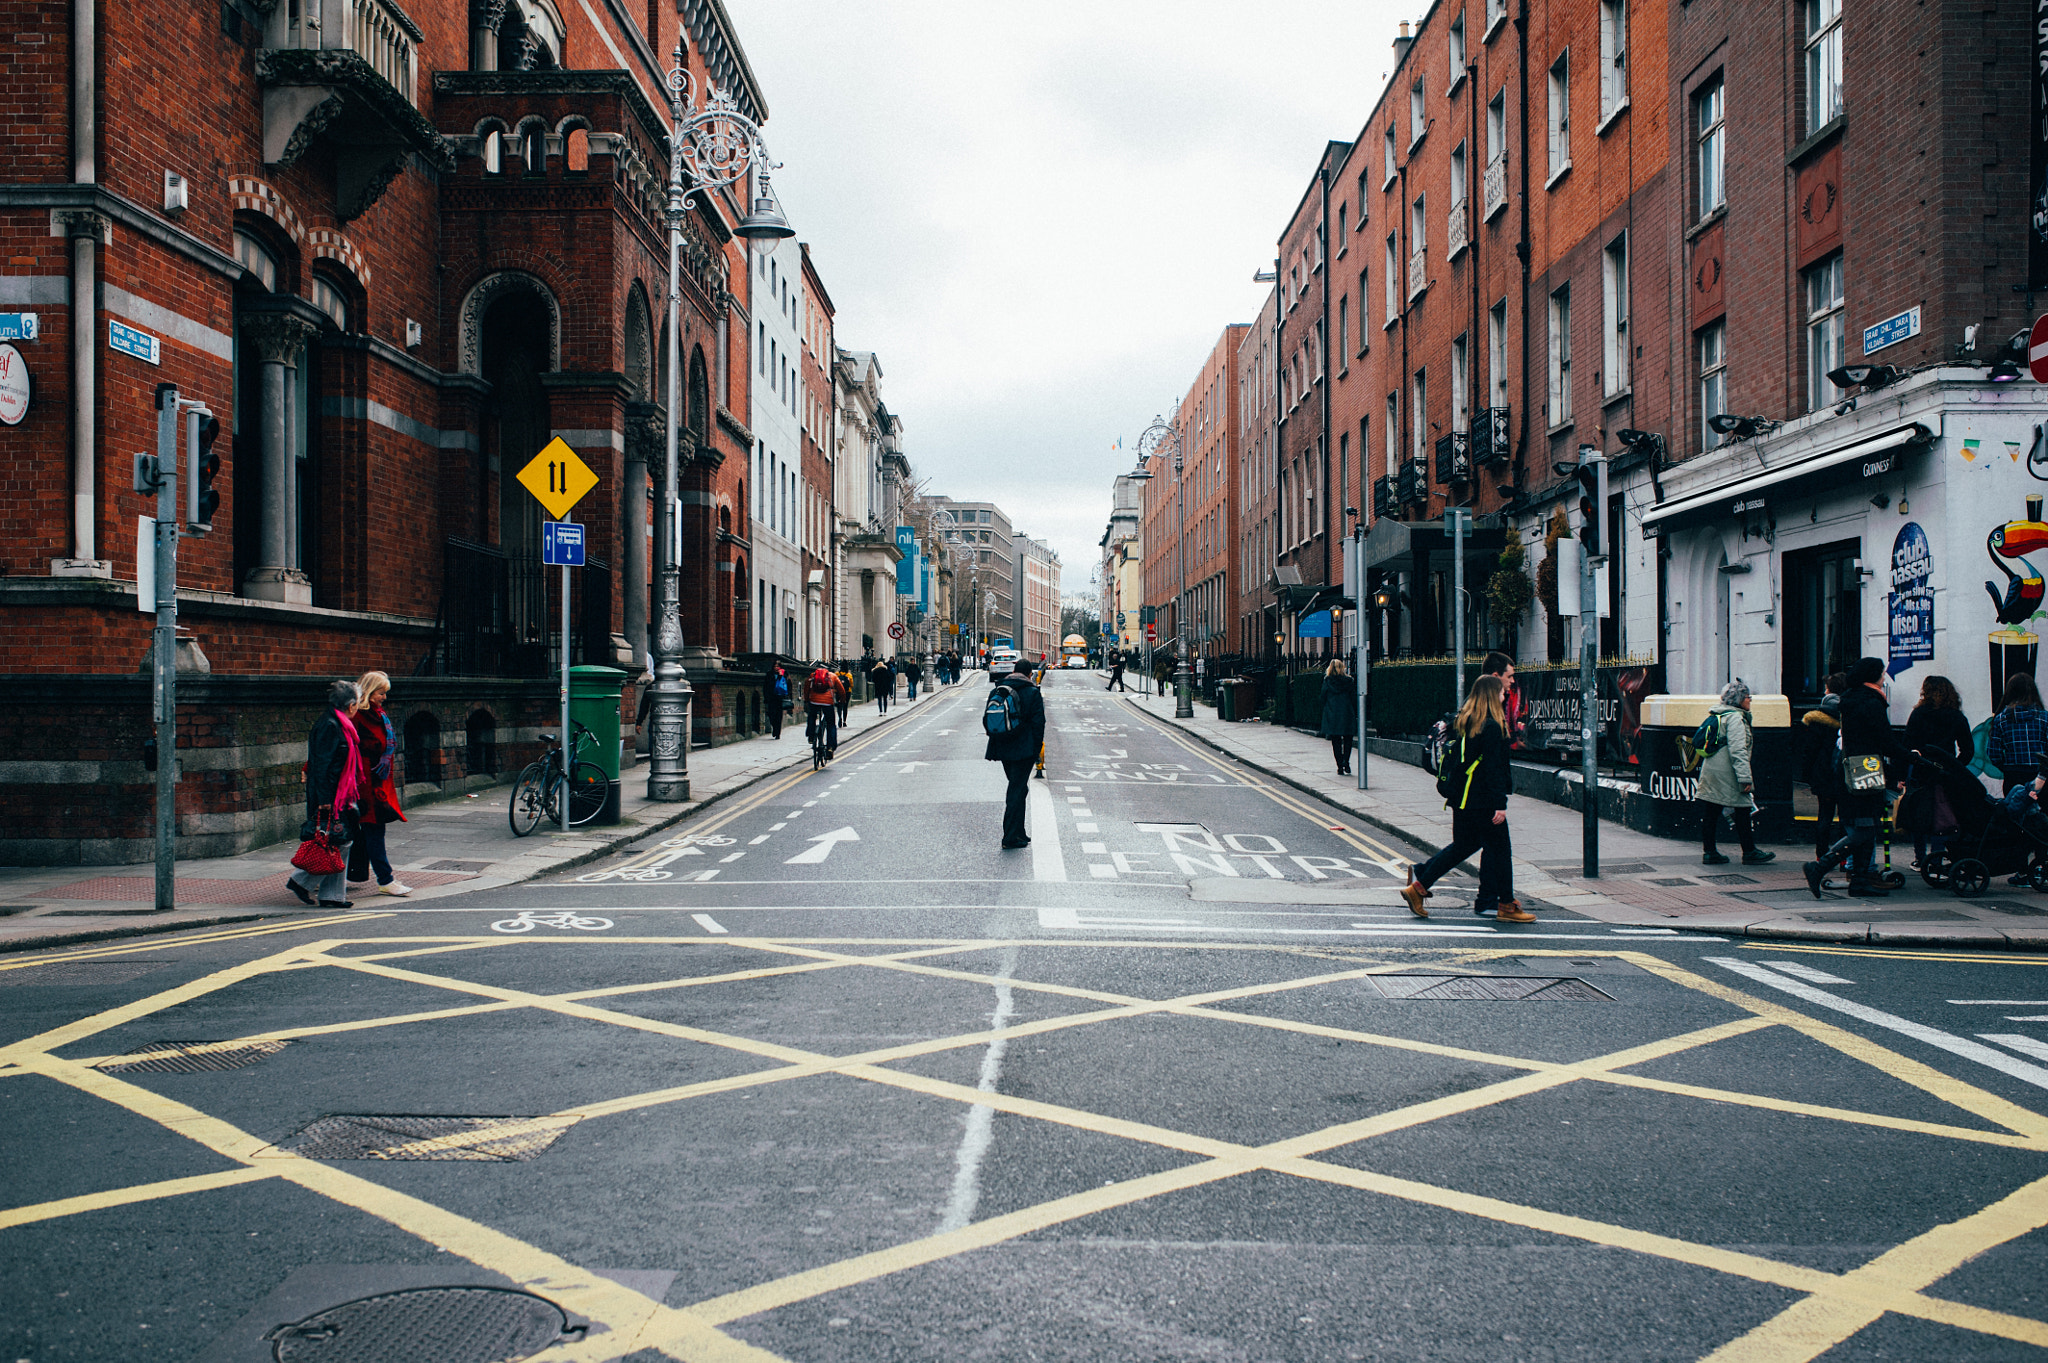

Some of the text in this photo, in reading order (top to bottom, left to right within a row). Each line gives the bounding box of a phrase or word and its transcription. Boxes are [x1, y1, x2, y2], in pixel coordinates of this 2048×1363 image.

[1895, 316, 1909, 328] DARA
[1912, 314, 1917, 328] 2
[113, 335, 149, 356] KILDARE STREET
[1867, 326, 1908, 350] KILDARE STREET
[153, 345, 157, 357] 2
[1863, 458, 1890, 478] GUINNESS
[1733, 498, 1765, 514] club nassau
[1896, 536, 1925, 567] club
[1889, 554, 1934, 588] nassau
[1920, 598, 1931, 611] 90s
[1892, 614, 1918, 636] disco
[1161, 829, 1288, 853] NO
[1111, 851, 1410, 880] ENTRY
